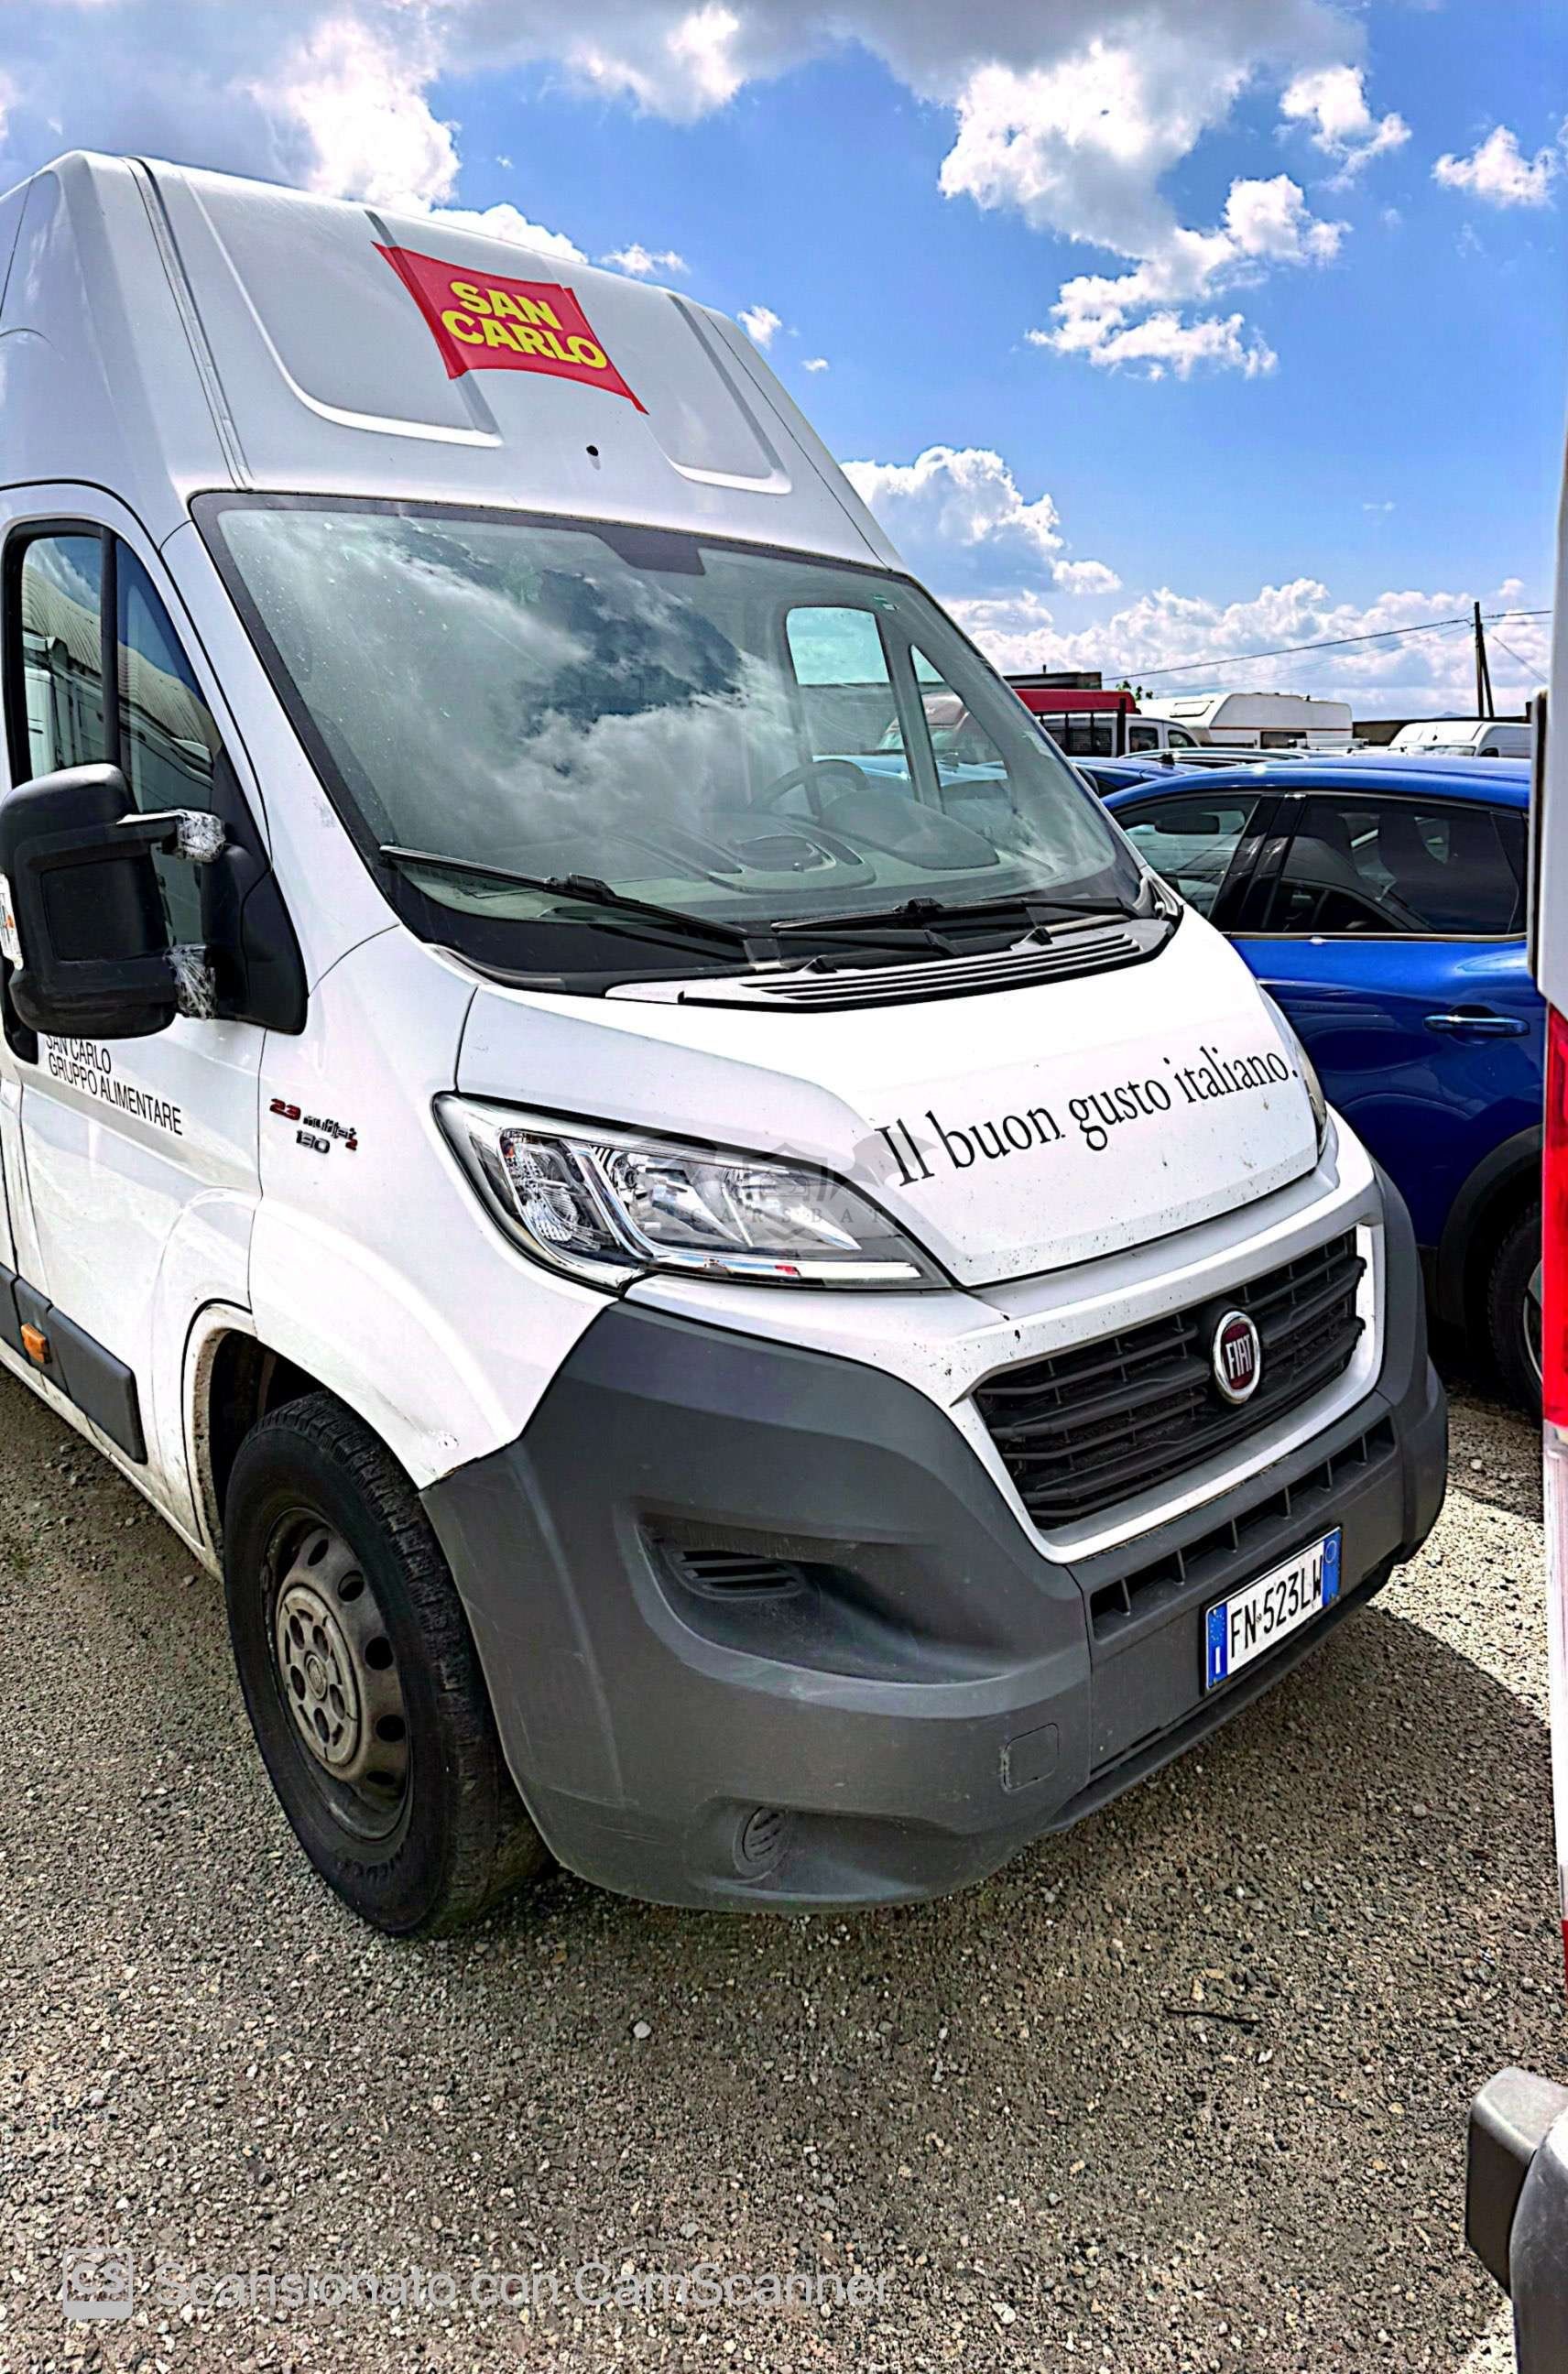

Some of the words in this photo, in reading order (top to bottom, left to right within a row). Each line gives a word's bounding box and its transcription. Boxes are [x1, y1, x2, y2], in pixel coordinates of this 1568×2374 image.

[450, 281, 563, 330] SAN
[441, 310, 607, 368] CARLO
[46, 1035, 68, 1056] SAN
[70, 1039, 111, 1074] CARLO
[49, 1052, 97, 1094] GRUPPO
[101, 1075, 183, 1136] ALIMENTARE
[875, 1118, 935, 1187] Il
[926, 1111, 1065, 1169] buon
[1068, 1078, 1171, 1151] gusto
[1163, 1046, 1299, 1104] italiano.
[296, 1130, 331, 1154] 130
[1225, 1334, 1253, 1379] FIAT
